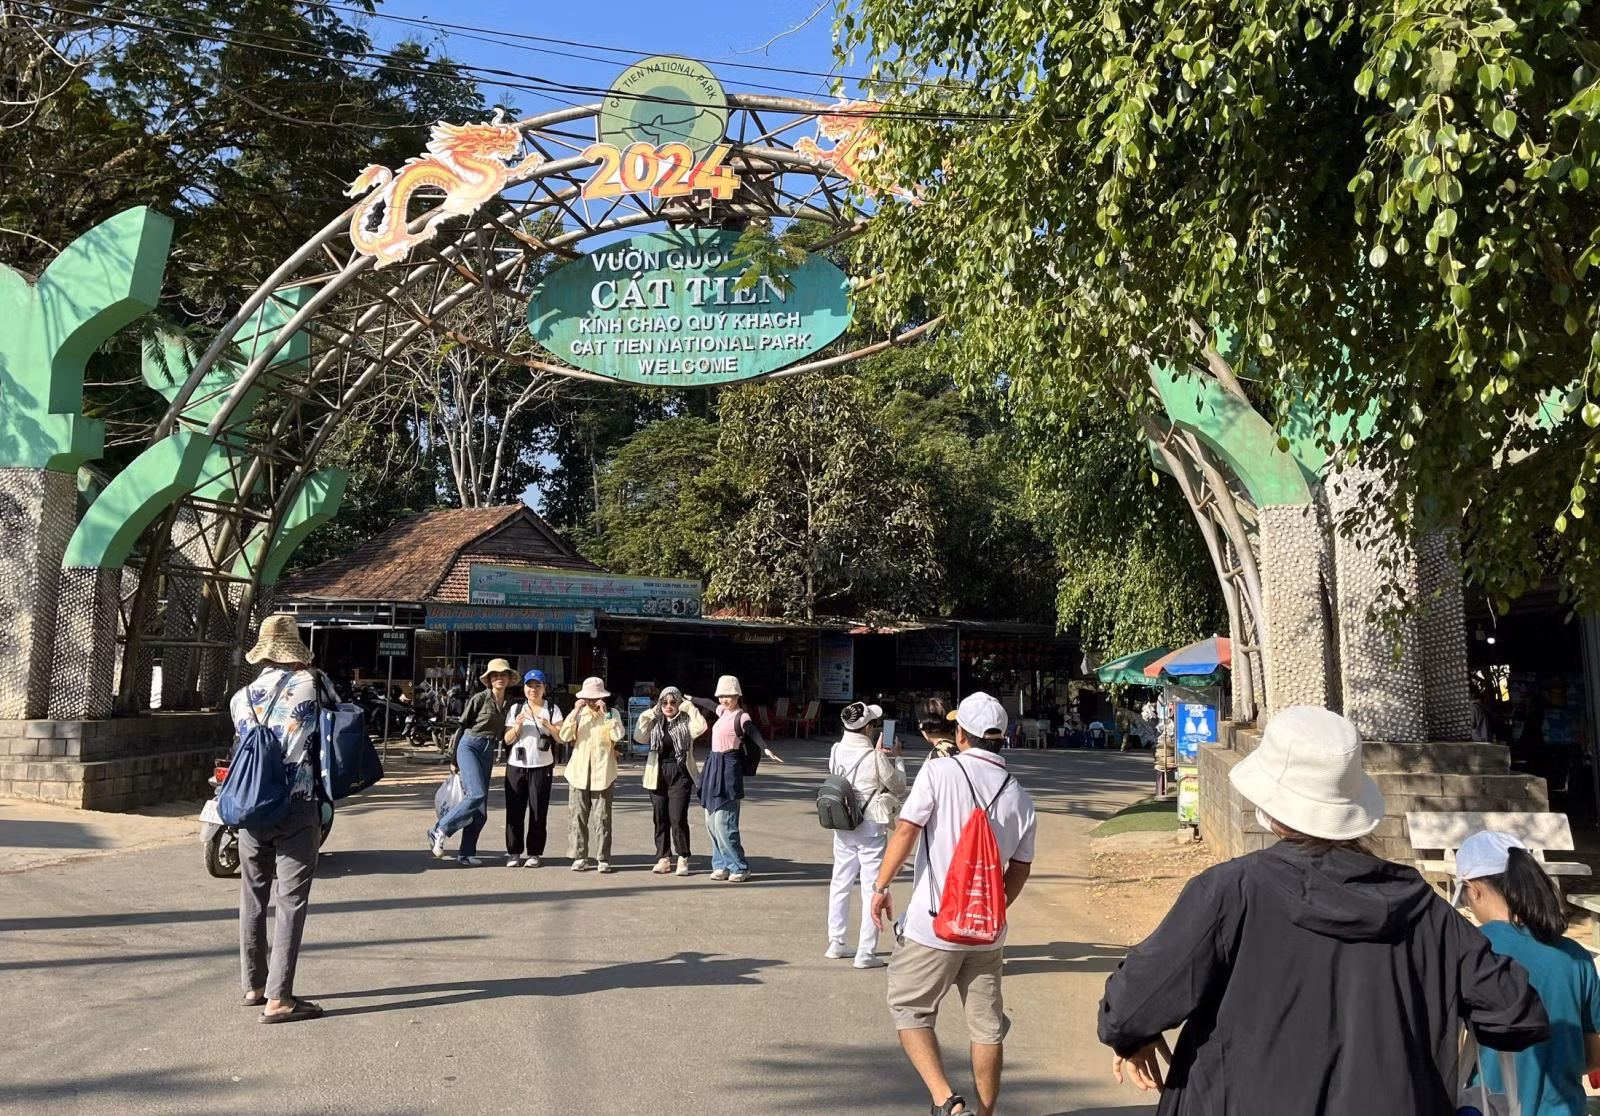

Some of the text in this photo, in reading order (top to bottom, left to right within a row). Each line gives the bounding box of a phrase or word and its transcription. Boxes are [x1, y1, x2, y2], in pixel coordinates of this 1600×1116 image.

[622, 69, 645, 88] TIEN
[646, 62, 695, 78] NATIONAL
[696, 75, 717, 100] PARK
[582, 143, 741, 199] 2024
[592, 247, 660, 271] VƯỜN
[591, 272, 674, 309] CÁT
[580, 315, 623, 333] KÍNH
[688, 311, 728, 331] QUÝ
[734, 310, 801, 329] KHÁCH
[570, 334, 811, 355] CAT TIEN NATIONAL PARK
[638, 357, 738, 374] WELCOME
